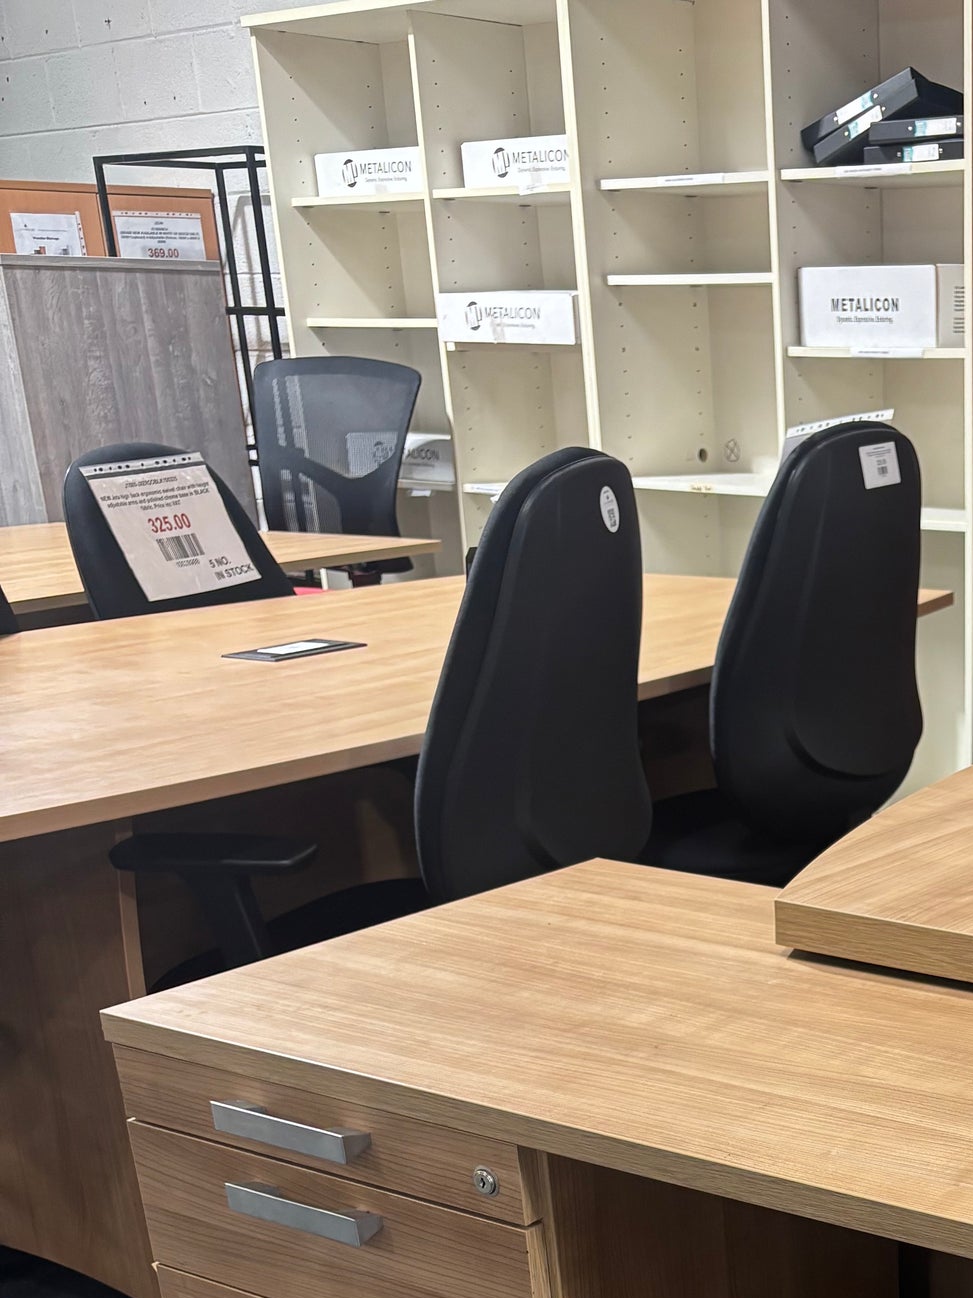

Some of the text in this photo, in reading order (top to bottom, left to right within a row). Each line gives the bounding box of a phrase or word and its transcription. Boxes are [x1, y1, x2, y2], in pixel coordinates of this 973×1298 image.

[360, 160, 411, 174] METALICON
[147, 248, 180, 258] 369.00
[831, 297, 900, 312] METALICON
[485, 306, 541, 319] METALICON
[148, 513, 191, 533] 325.00
[208, 559, 215, 568] 5
[215, 556, 231, 567] NO.
[224, 563, 254, 578] STOCK
